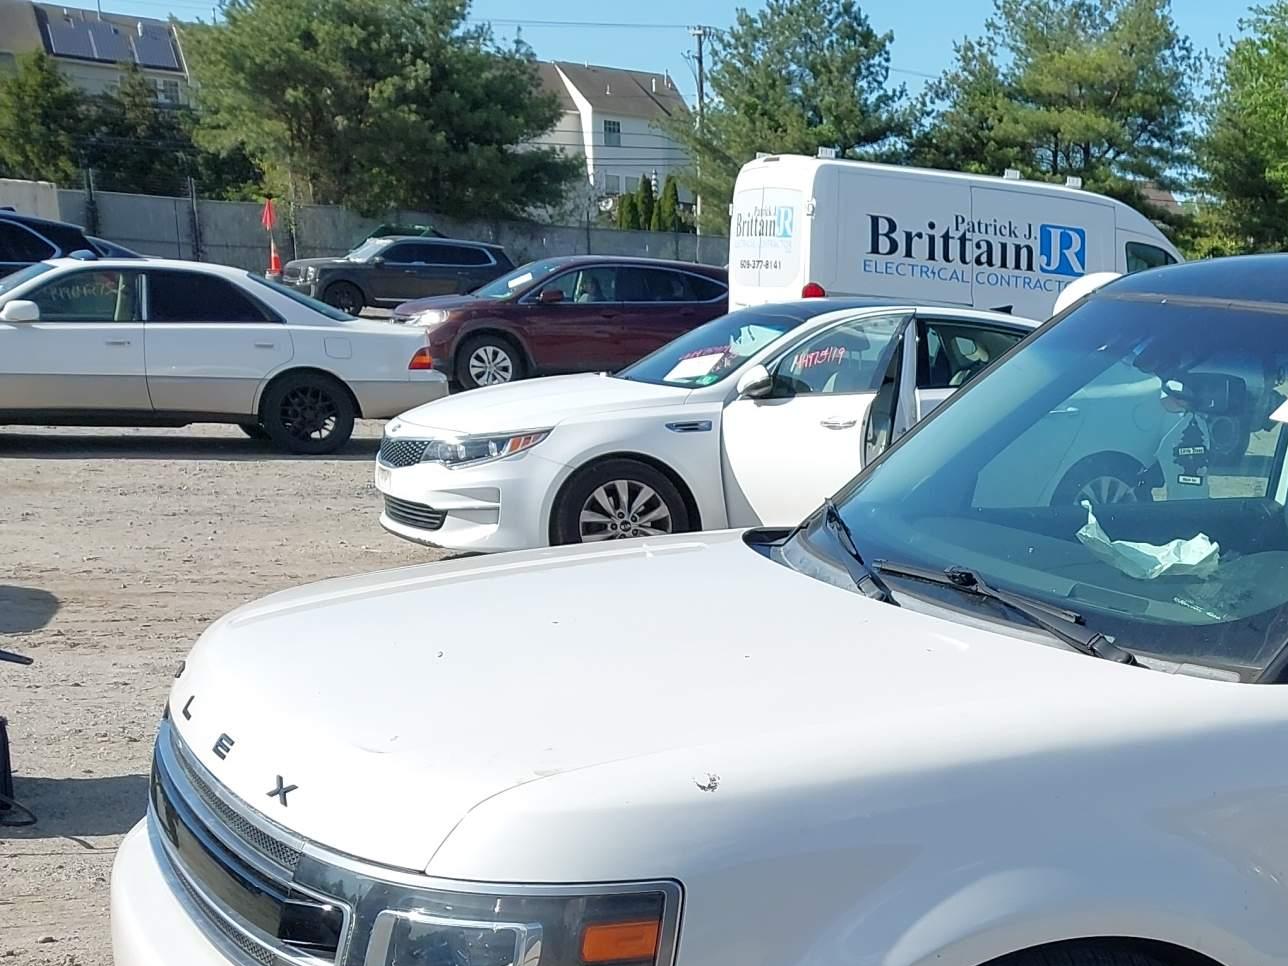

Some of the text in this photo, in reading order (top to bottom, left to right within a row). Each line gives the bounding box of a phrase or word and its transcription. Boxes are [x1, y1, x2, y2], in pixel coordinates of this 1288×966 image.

[736, 212, 776, 238] Brittain
[954, 214, 1038, 241] Patrick J.
[866, 213, 1086, 274] Brittain JR
[863, 259, 970, 284] ELECTRICAL
